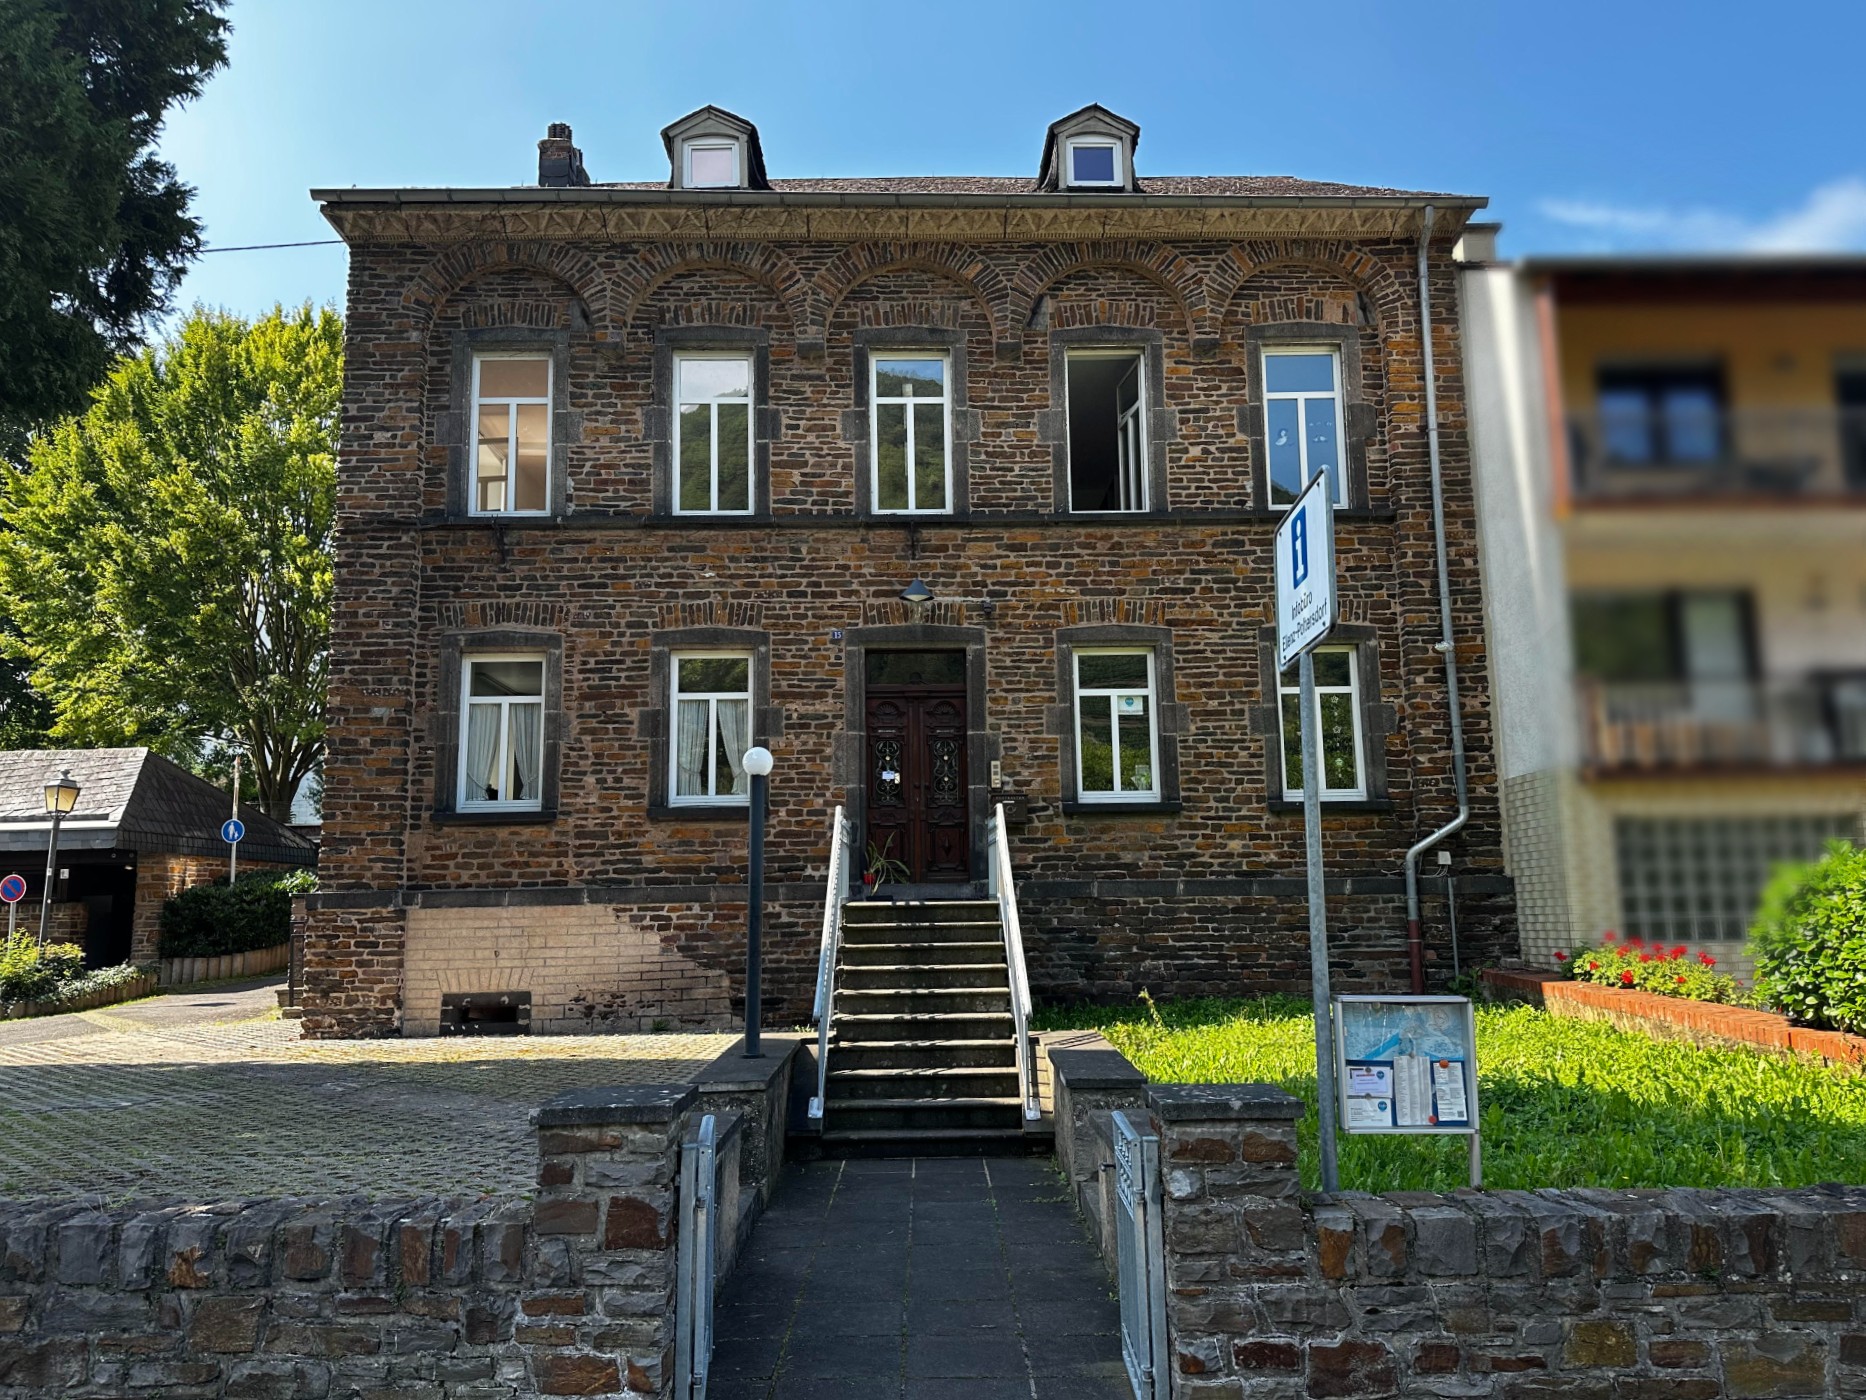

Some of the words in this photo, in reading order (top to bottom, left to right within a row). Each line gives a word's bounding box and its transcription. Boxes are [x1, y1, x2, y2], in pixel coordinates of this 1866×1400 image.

[1291, 592, 1312, 621] Infobüro
[834, 631, 842, 639] 15
[1283, 598, 1327, 652] Ellenz-Poltersdorf
